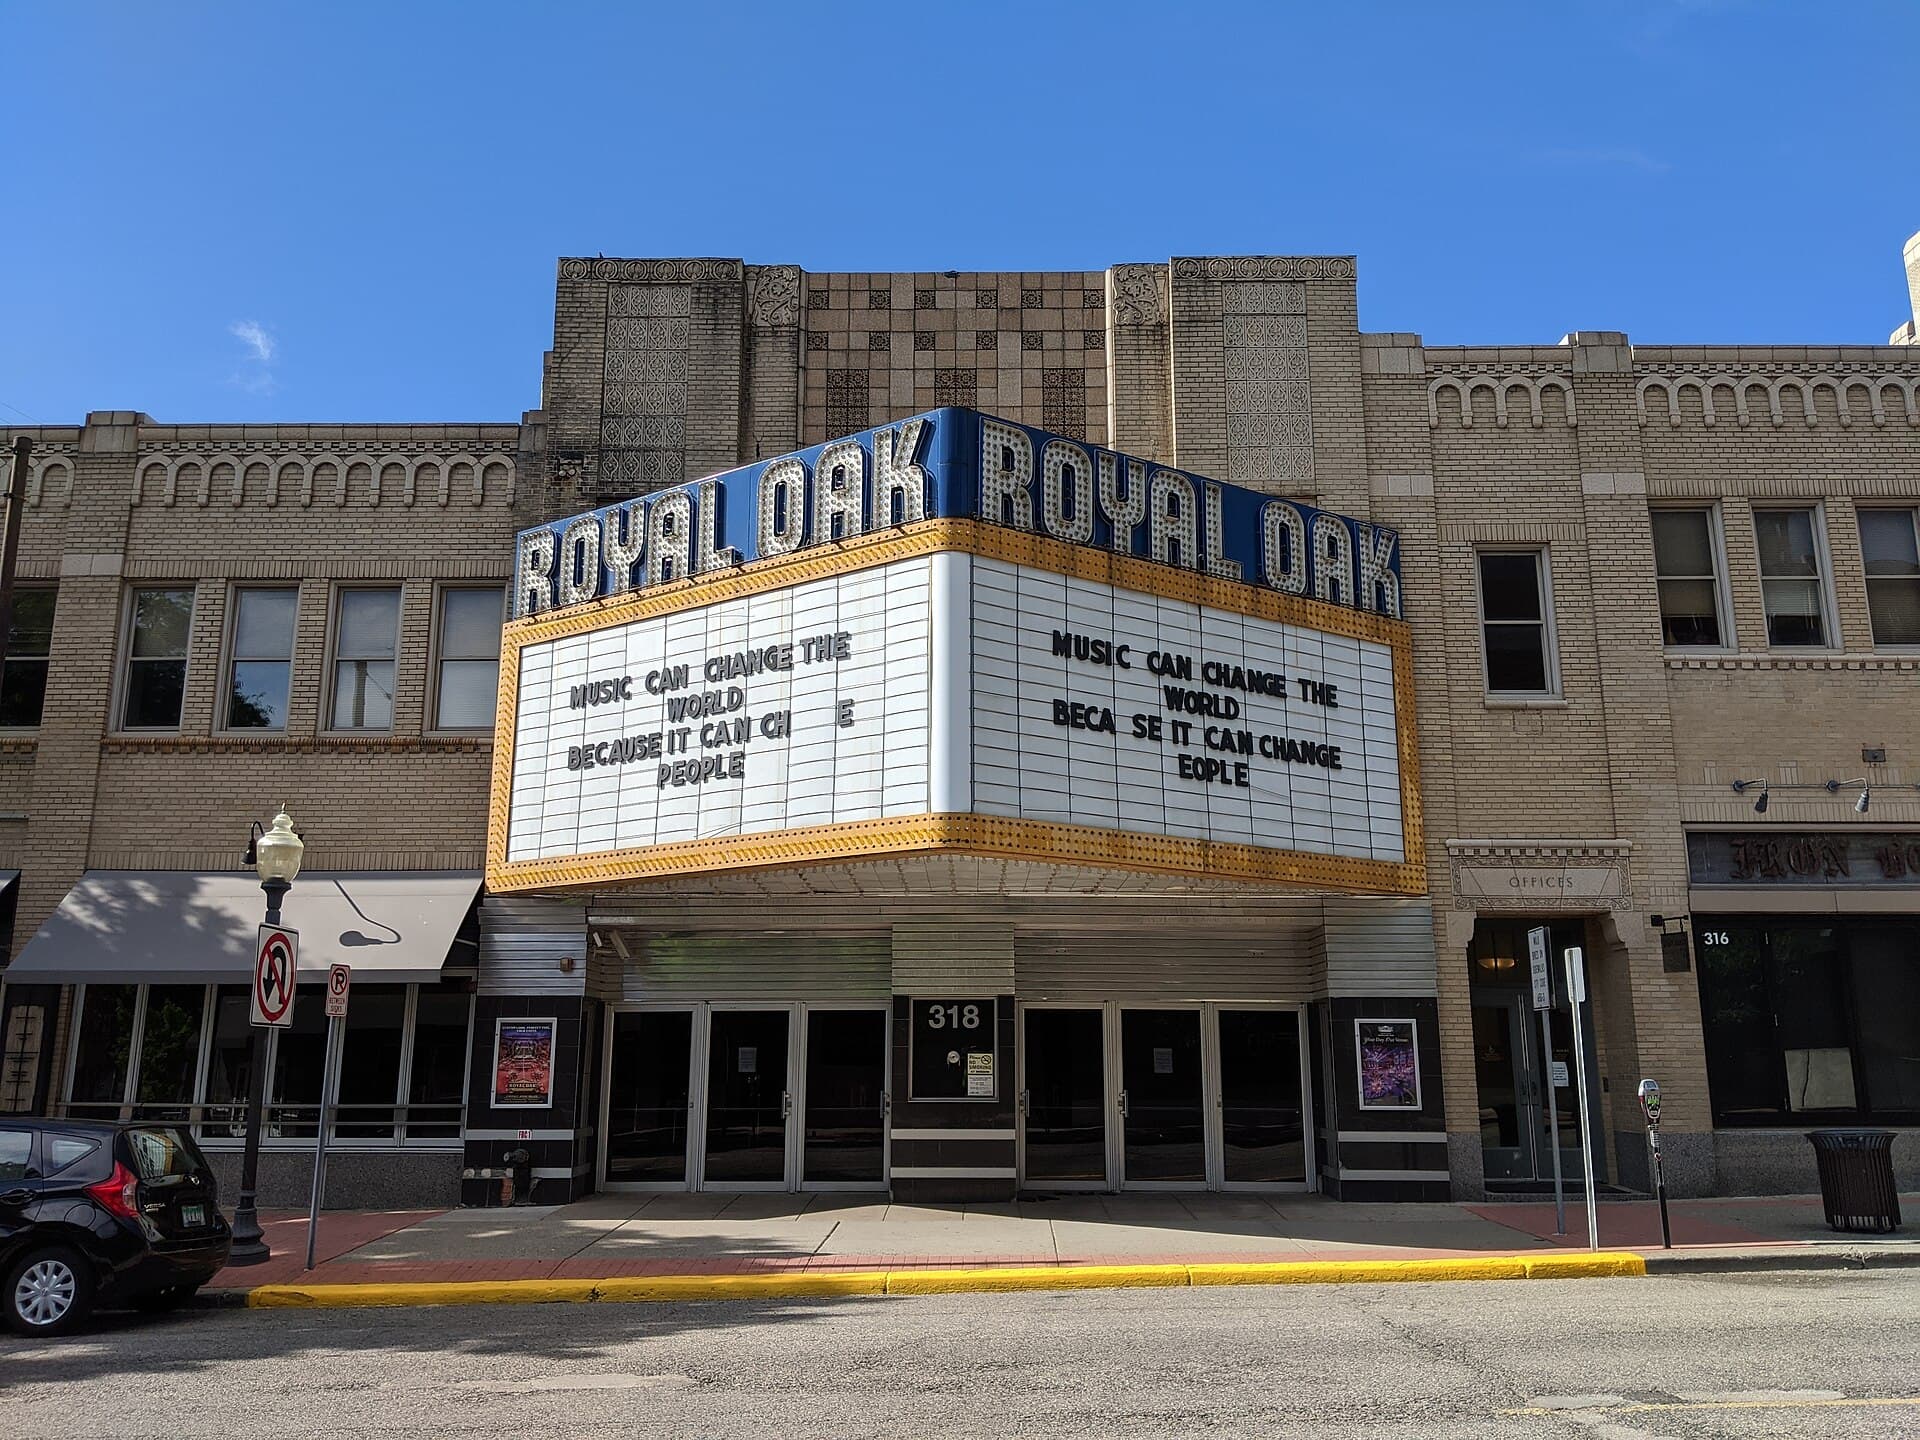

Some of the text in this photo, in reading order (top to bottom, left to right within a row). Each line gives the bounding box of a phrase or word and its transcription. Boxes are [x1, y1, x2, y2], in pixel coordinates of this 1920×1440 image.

[517, 418, 929, 617] ROYAL OAK
[980, 417, 1401, 620] ROYAL OAK
[570, 631, 852, 710] MUSIC CAN CHANGE THE
[1052, 630, 1338, 708] MUSIC CAN CHANGE THE
[667, 686, 745, 723] WORLD
[1163, 685, 1240, 720] WORLD
[568, 698, 855, 771] BECAUSE IT CAN CH E
[1172, 720, 1192, 746] IT
[1205, 726, 1254, 755] CAN
[1259, 735, 1342, 770] CHANGE
[657, 750, 745, 790] PEOPLE
[1178, 753, 1249, 787] EOPLE
[1509, 877, 1573, 888] OFFICES
[1704, 932, 1729, 945] 316
[928, 1005, 980, 1029] 318
